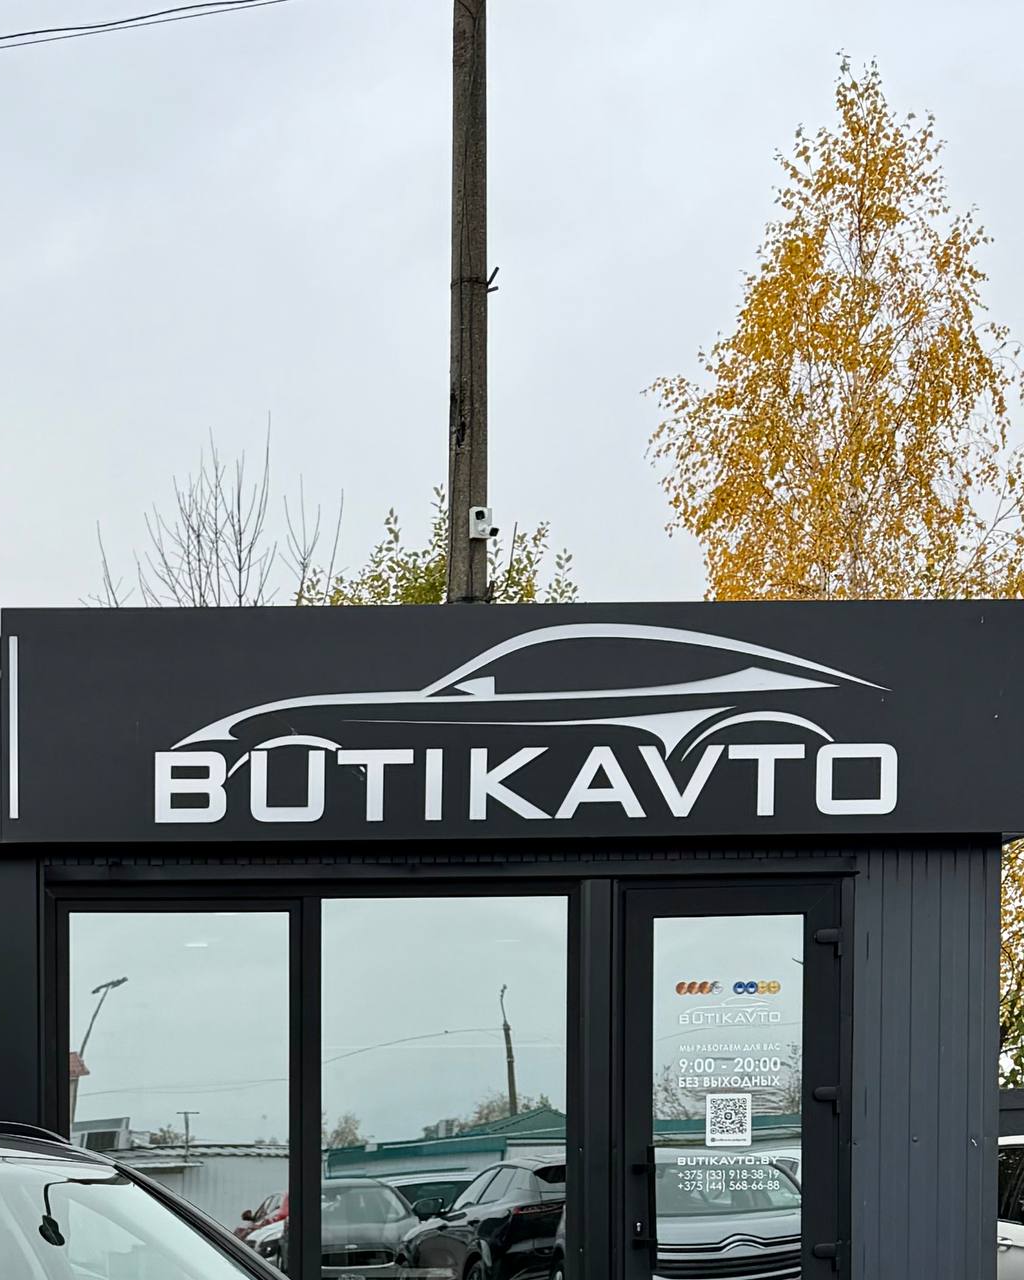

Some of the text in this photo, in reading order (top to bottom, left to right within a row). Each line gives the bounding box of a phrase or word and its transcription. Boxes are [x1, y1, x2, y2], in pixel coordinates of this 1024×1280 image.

[154, 742, 898, 823] BUTIKAVTO
[679, 1012, 781, 1025] BUTIKAVTO
[679, 1058, 715, 1073] 9:00
[733, 1057, 781, 1073] 20:00
[678, 1075, 780, 1088] БЕЗ ВЫХОДНЫХ
[677, 1156, 779, 1166] BUTIKAVTO.BY
[678, 1169, 780, 1182] +375 (33) 918-38-19
[678, 1181, 780, 1192] +375 (44) 568-66-88
